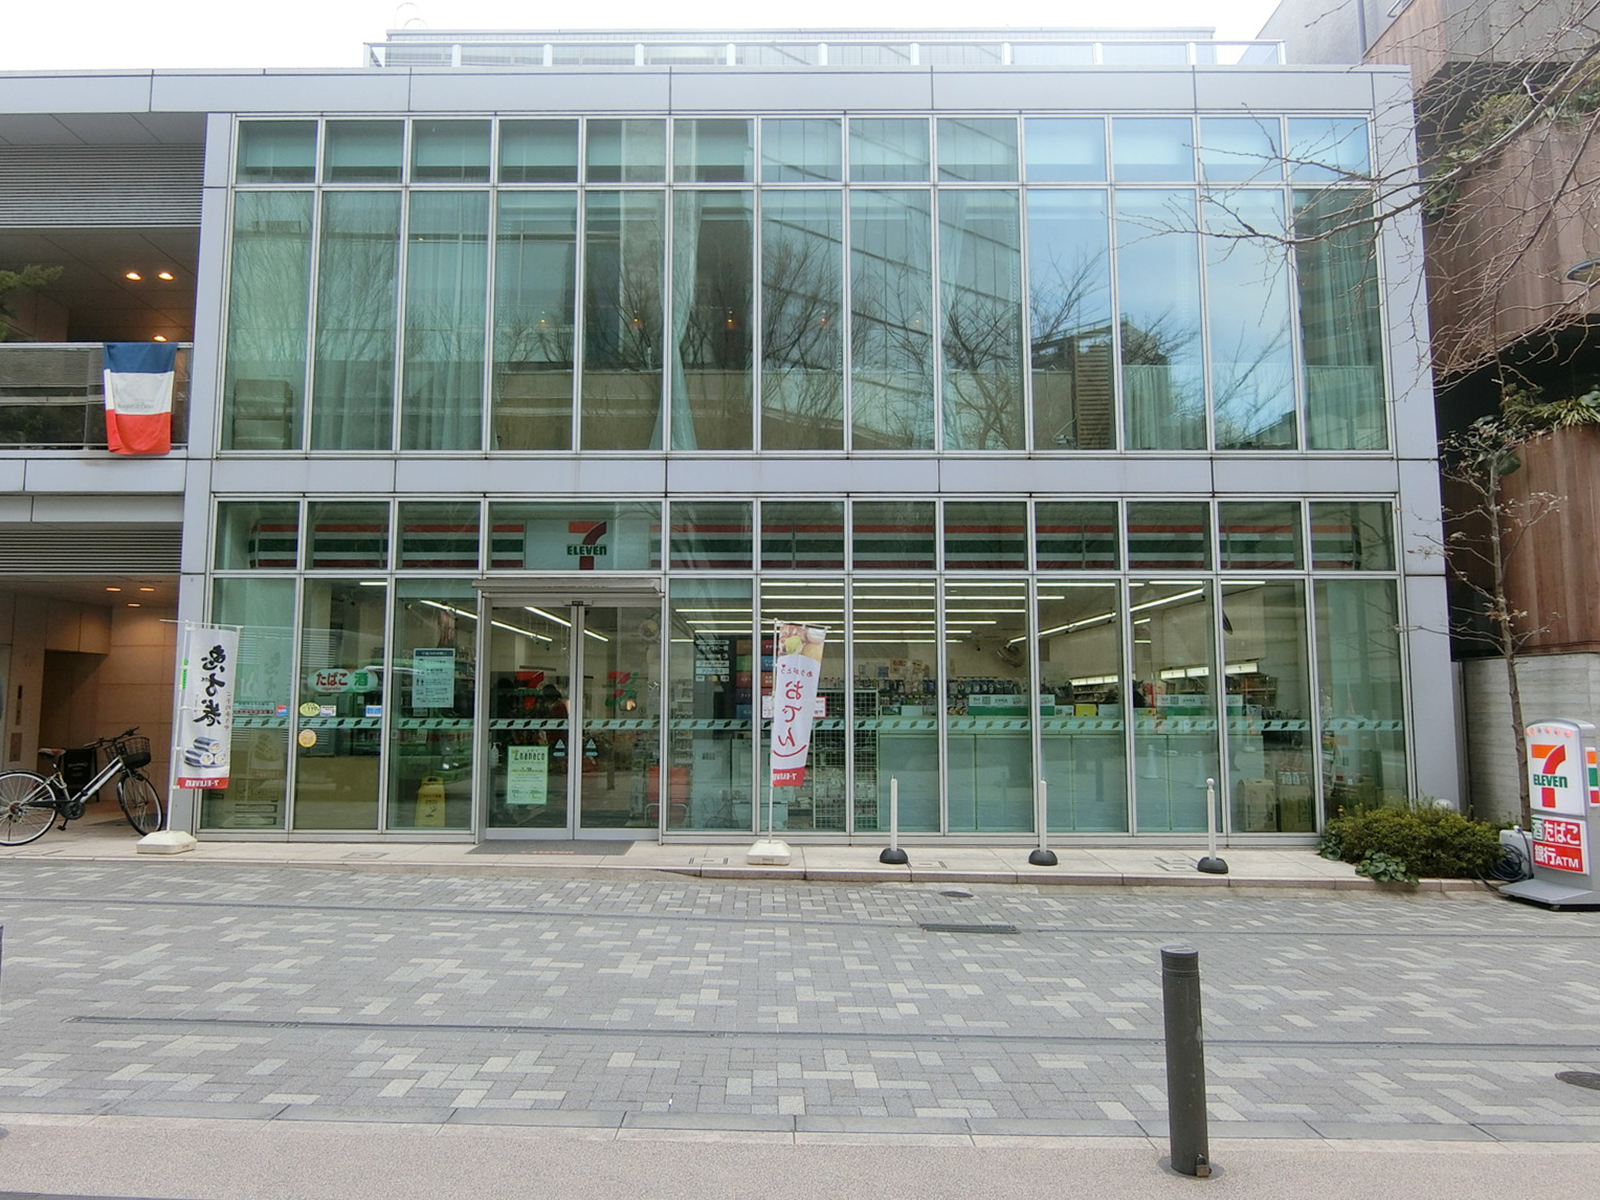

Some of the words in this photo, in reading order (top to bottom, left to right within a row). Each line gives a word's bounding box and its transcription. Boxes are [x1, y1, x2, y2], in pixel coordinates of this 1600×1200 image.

[316, 672, 348, 686] たばこ
[354, 672, 368, 686] 酒
[1532, 819, 1543, 841] 酒
[1544, 821, 1580, 844] たばこ
